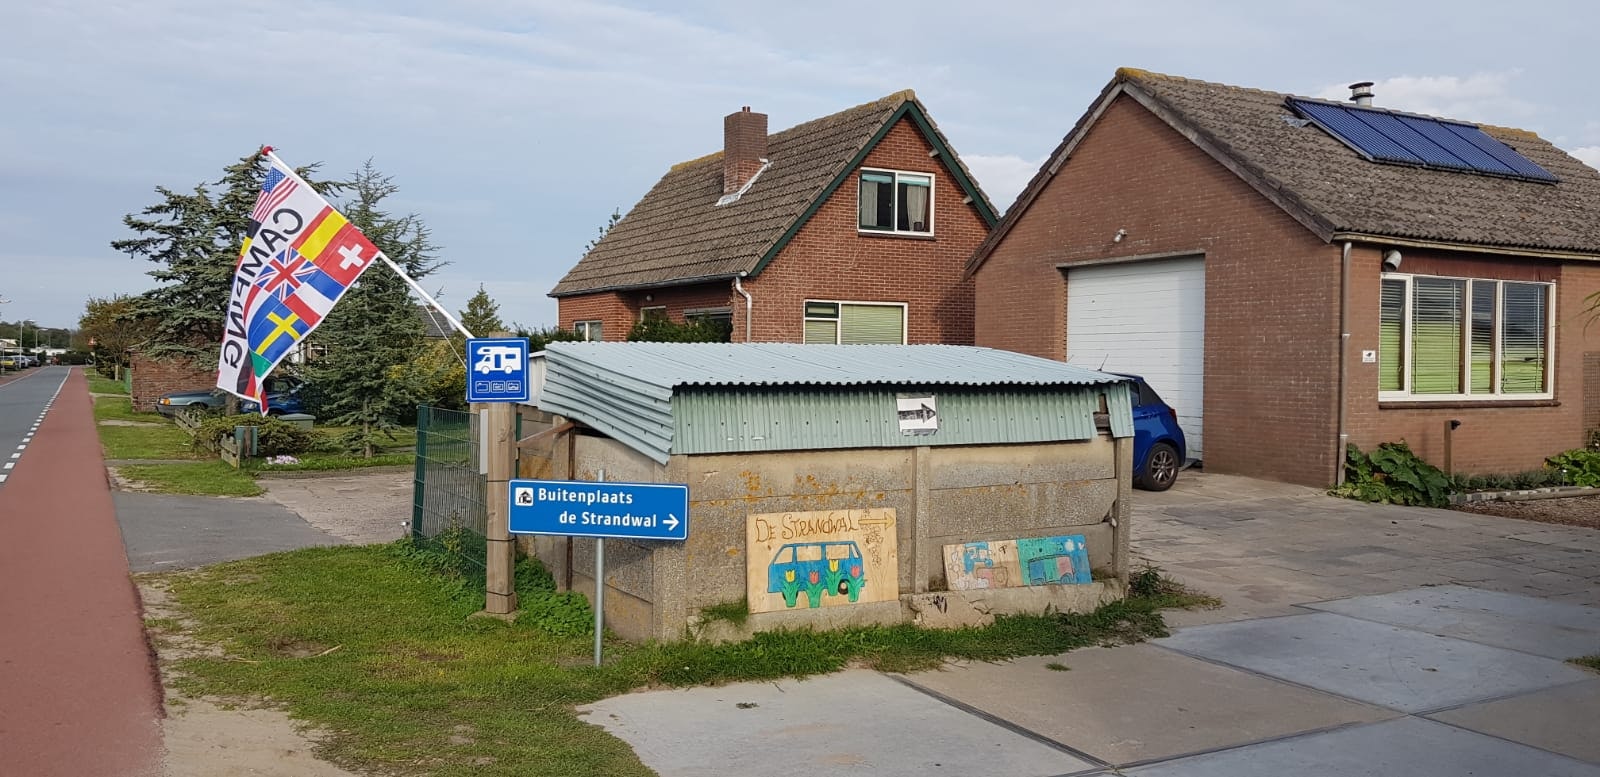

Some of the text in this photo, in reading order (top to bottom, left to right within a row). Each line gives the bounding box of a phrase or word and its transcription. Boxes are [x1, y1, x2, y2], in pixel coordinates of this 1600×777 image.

[538, 488, 633, 506] Buitenplaats
[559, 510, 657, 528] de Strandwal
